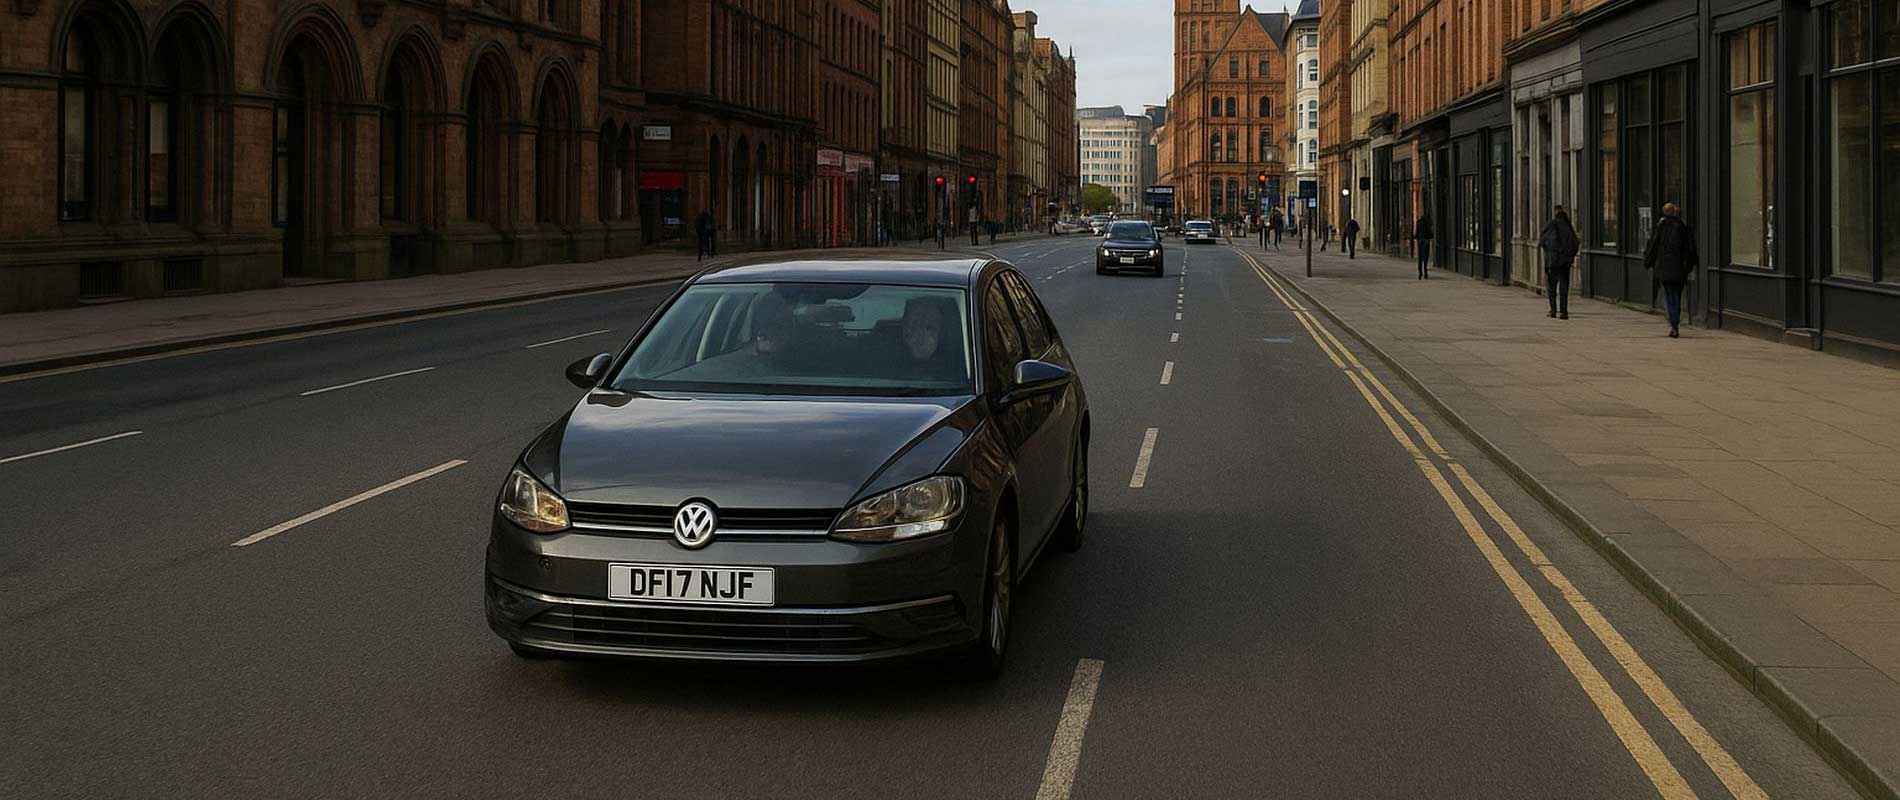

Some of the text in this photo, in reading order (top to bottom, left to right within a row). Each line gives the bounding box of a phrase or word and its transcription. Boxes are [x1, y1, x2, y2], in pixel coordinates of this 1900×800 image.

[676, 504, 713, 544] VW
[630, 568, 754, 599] DF17 NJF
